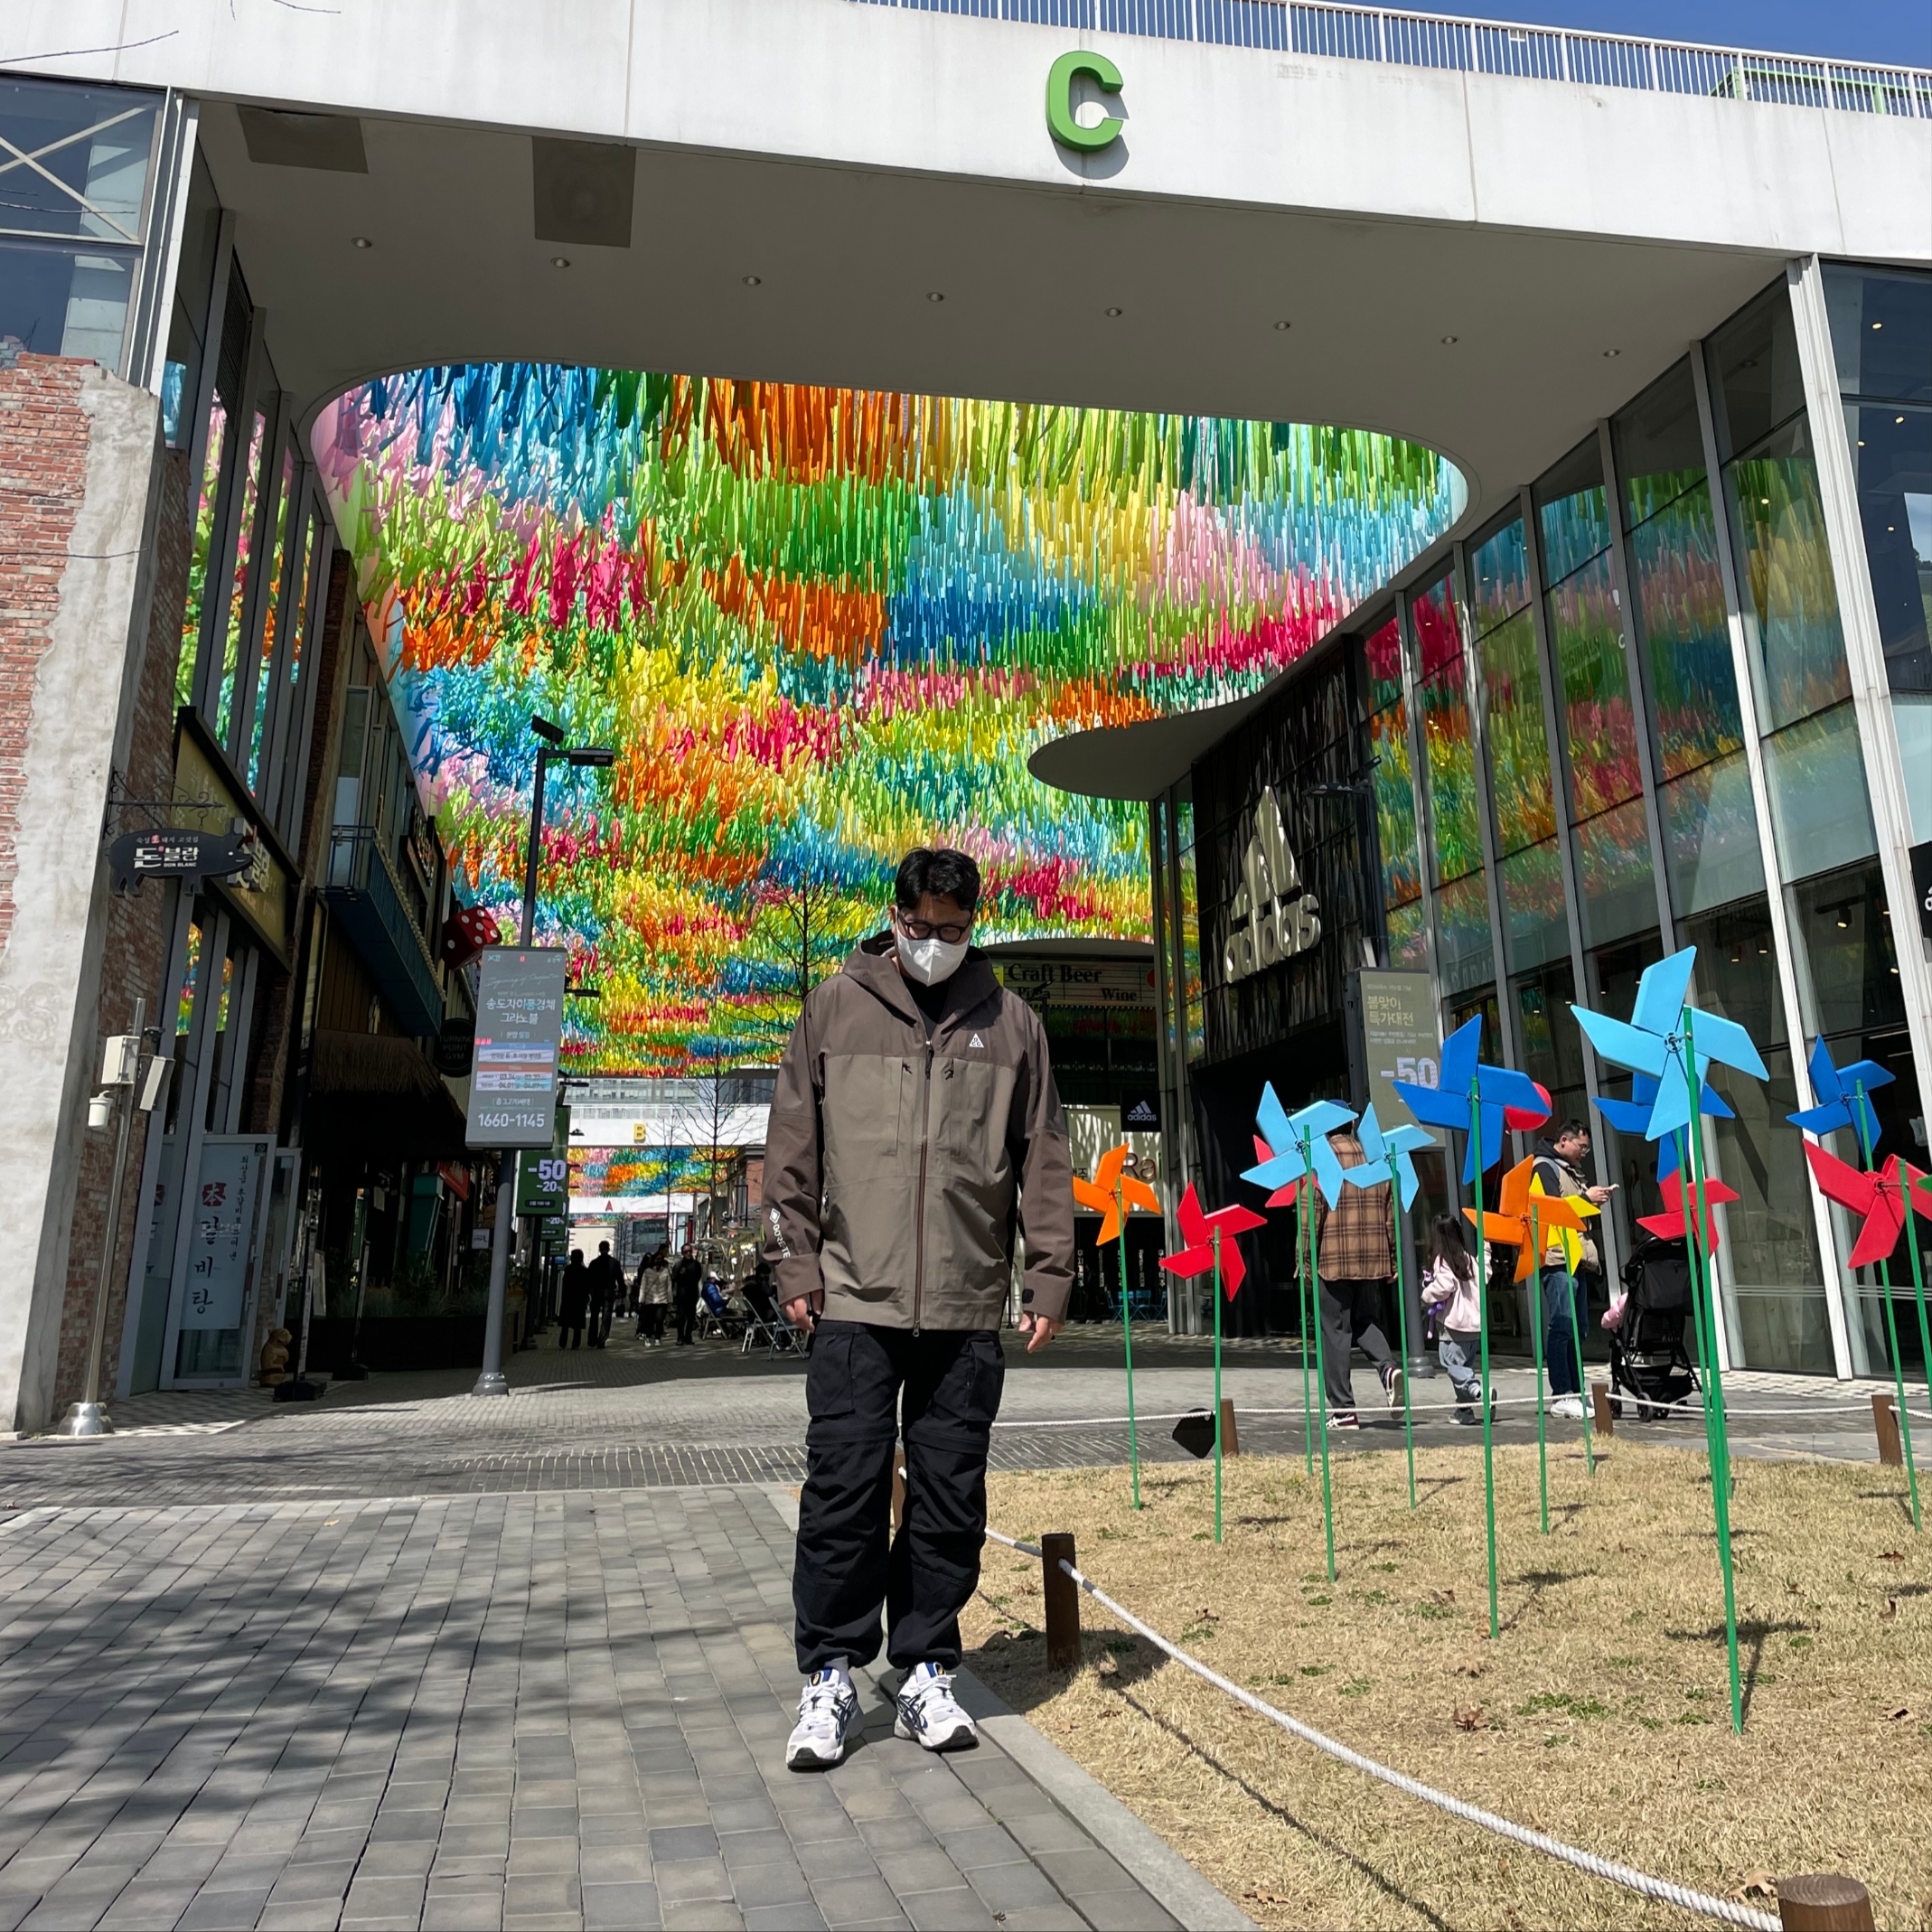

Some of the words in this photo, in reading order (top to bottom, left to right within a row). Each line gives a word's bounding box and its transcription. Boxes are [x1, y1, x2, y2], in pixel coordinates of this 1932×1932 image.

[1046, 50, 1123, 153] C
[1224, 894, 1321, 983] adidas
[1008, 962, 1055, 982] Craft
[1060, 964, 1102, 982] Beer
[1101, 988, 1138, 1001] Wine
[486, 998, 556, 1010] 송도자이풍경채
[1367, 996, 1401, 1010] 봄맞이
[500, 1012, 539, 1025] 그라노블
[1369, 1011, 1413, 1026] 특가대전
[439, 1035, 474, 1043] TURNING
[442, 1044, 468, 1052] POINT
[445, 1052, 465, 1061] GYM
[1380, 1056, 1439, 1090] -50
[477, 1112, 545, 1128] 1660-1145
[1127, 1112, 1157, 1121] adidas
[633, 1123, 646, 1142] B
[528, 1159, 567, 1180] -50
[605, 1200, 614, 1211] A
